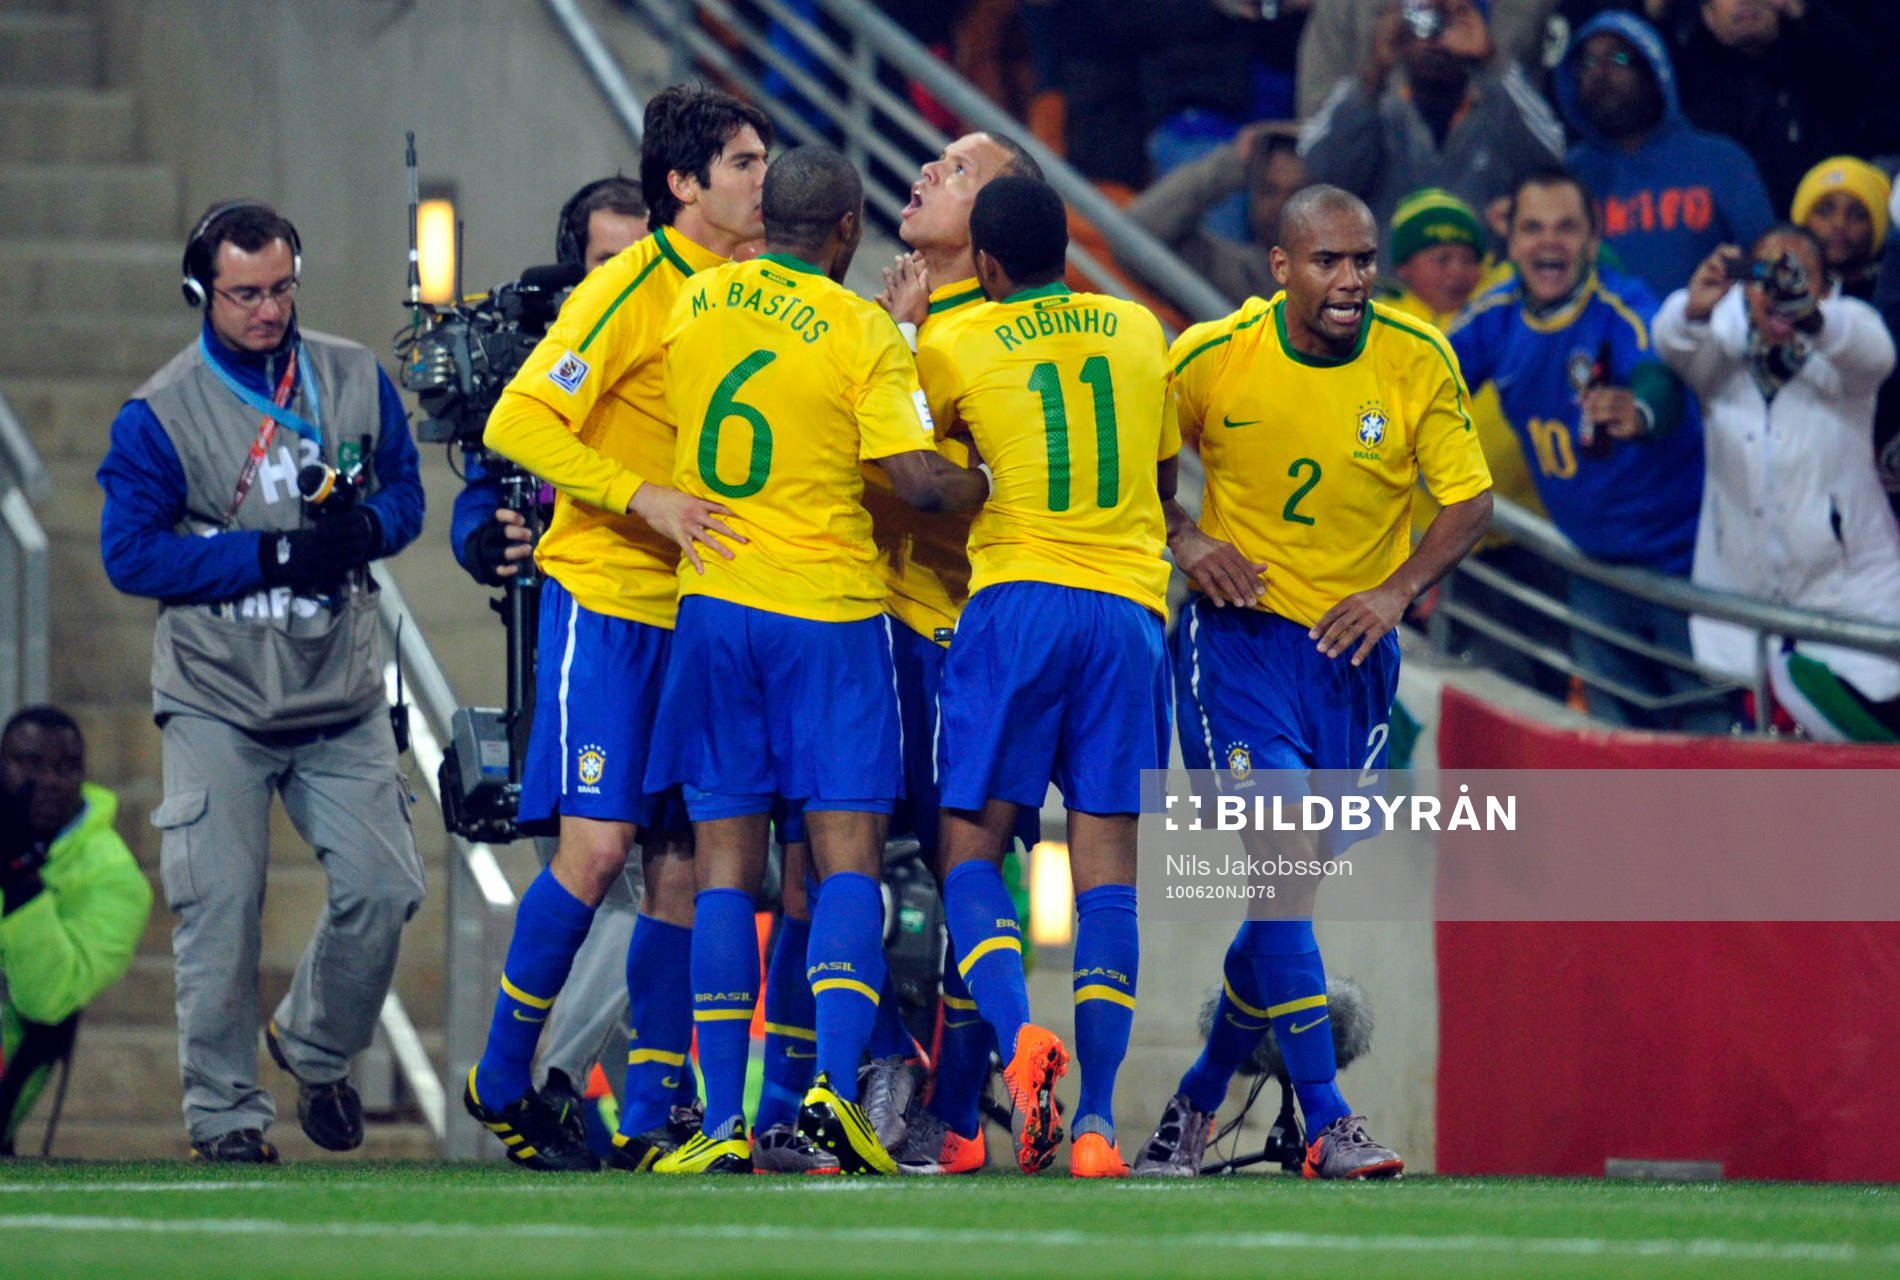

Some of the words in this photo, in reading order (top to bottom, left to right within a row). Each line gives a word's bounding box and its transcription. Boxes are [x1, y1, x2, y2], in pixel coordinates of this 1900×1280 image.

[691, 287, 717, 318] M.
[726, 281, 829, 344] BASTOS
[993, 308, 1118, 351] ROBINHO
[697, 348, 777, 499] 6
[1027, 355, 1120, 512] 11
[1527, 418, 1578, 479] 10
[1282, 457, 1322, 526] 2
[1357, 723, 1389, 788] 2
[695, 992, 753, 1003] BRASIL
